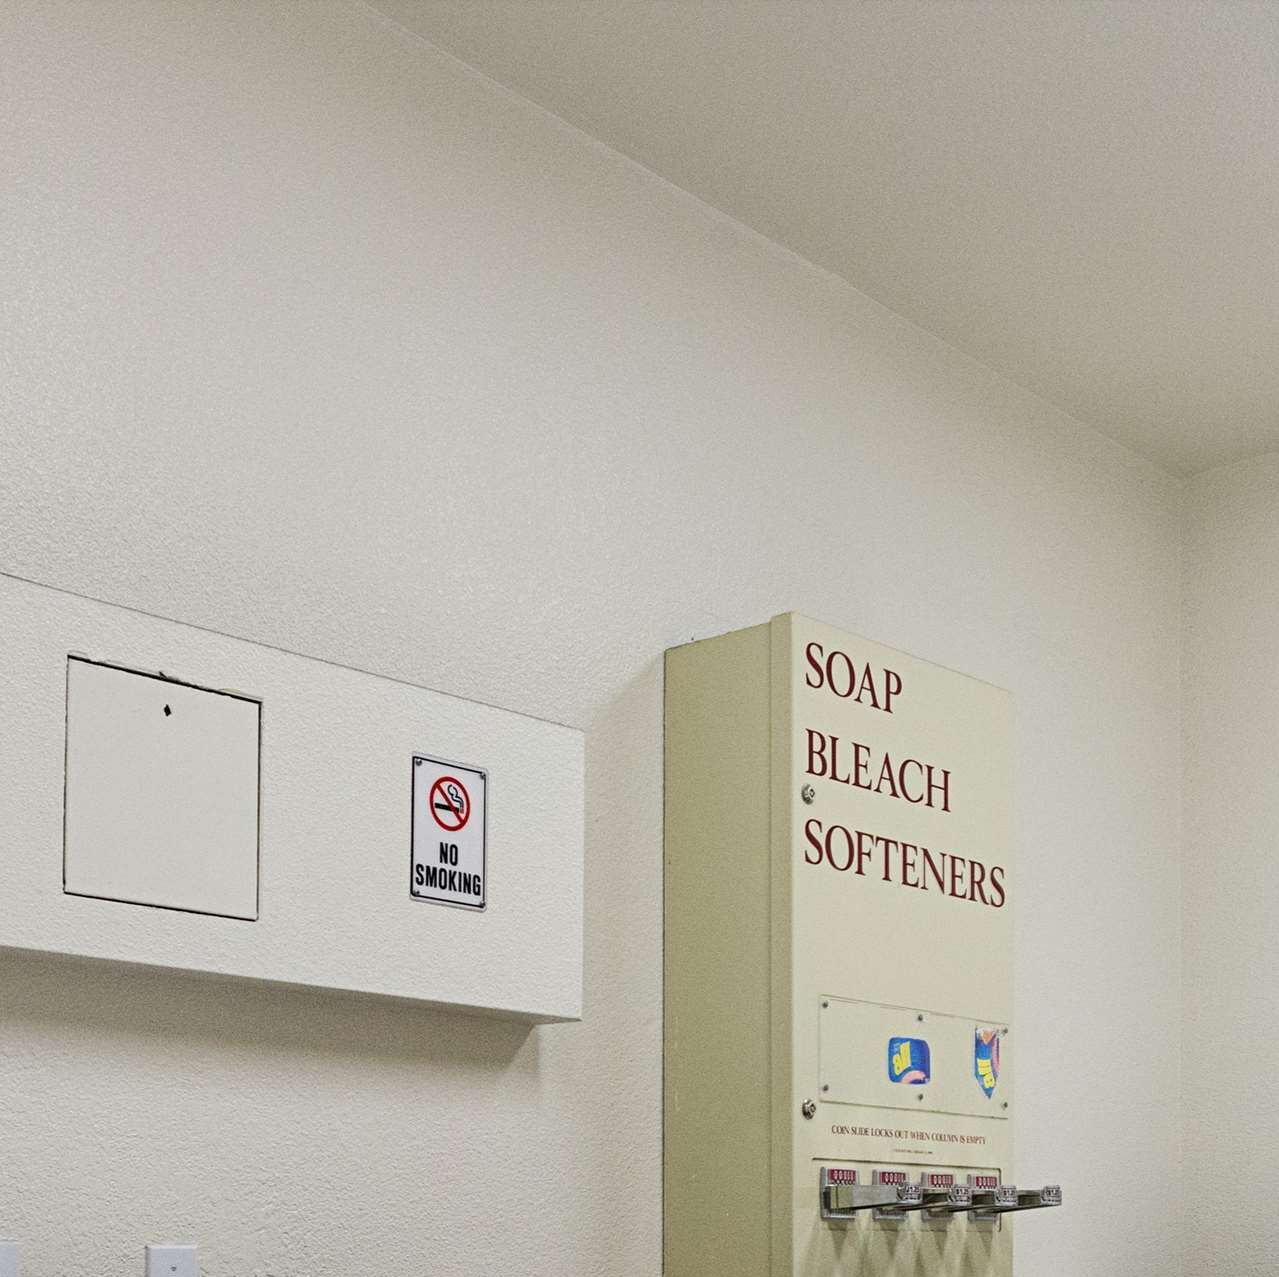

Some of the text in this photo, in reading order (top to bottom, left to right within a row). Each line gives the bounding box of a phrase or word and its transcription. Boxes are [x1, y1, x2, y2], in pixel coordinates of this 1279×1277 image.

[804, 641, 903, 714] SOAP
[804, 727, 952, 813] BLEACH
[415, 863, 481, 896] SMOKING
[439, 842, 459, 866] NO
[803, 818, 1006, 909] SOFTENERS
[831, 1125, 850, 1135] COIN
[850, 1126, 870, 1136] SLIDE
[870, 1127, 894, 1138] LOCKS
[894, 1129, 909, 1139] OUT
[910, 1131, 930, 1141] WHEN
[931, 1132, 959, 1144] COLUMN
[966, 1135, 987, 1145] EMPTY
